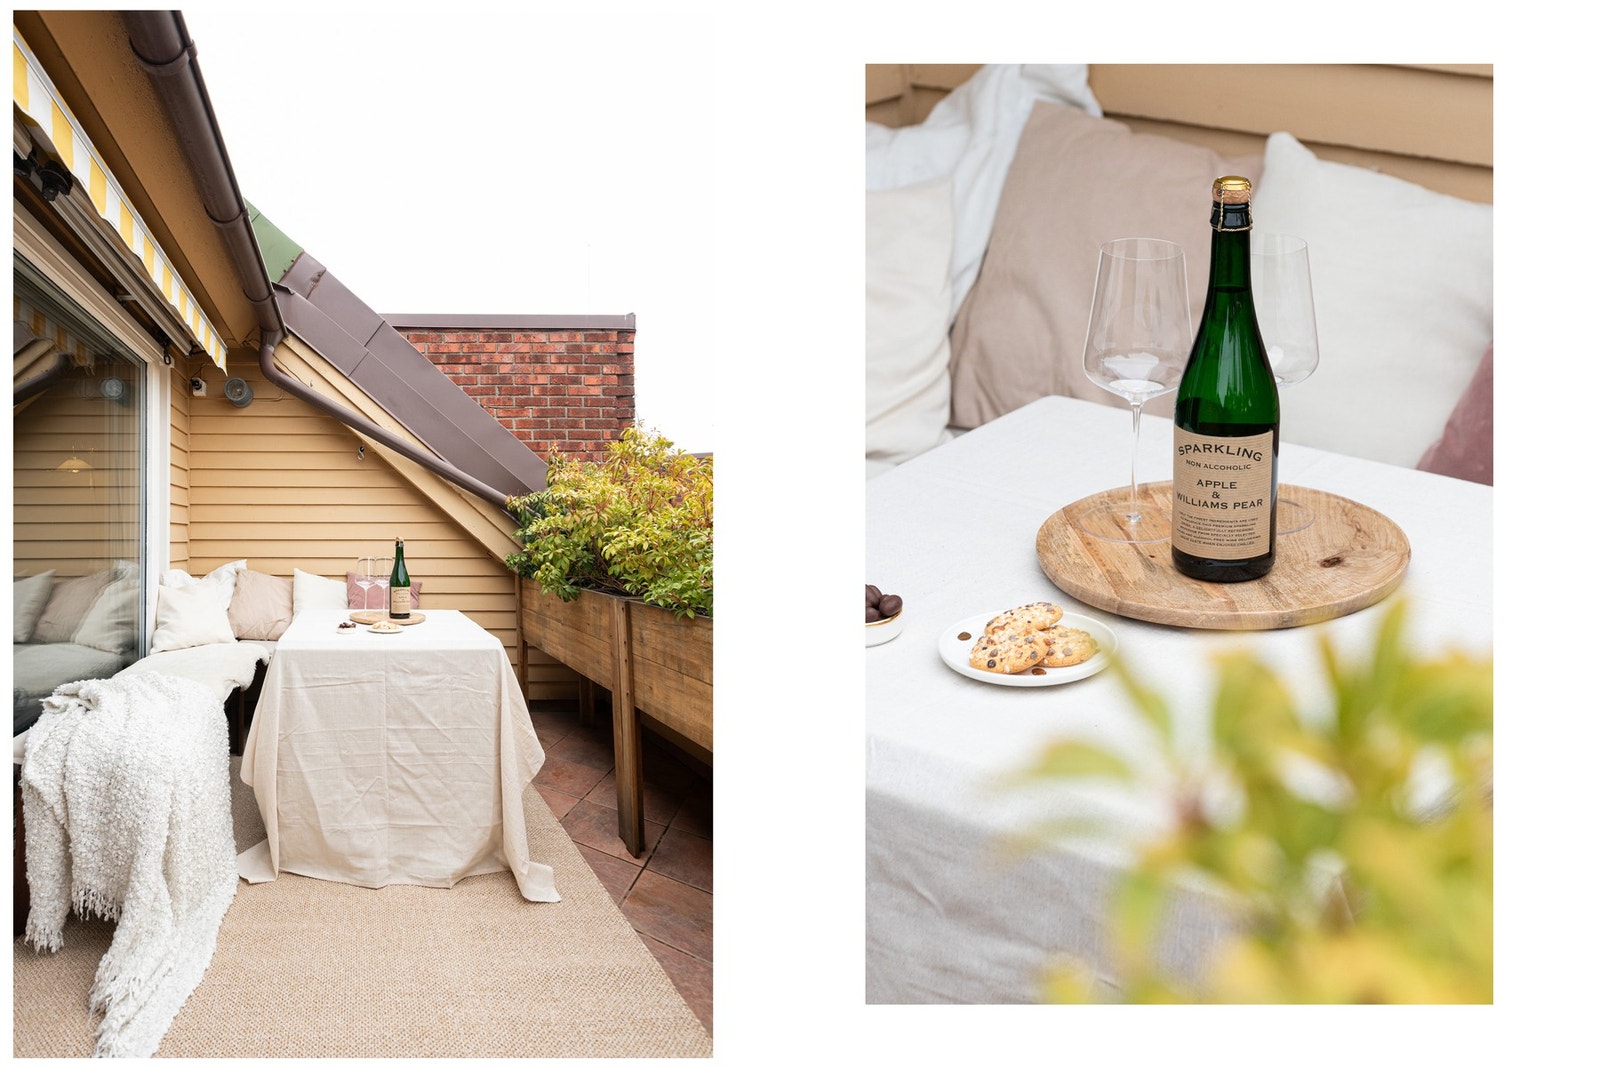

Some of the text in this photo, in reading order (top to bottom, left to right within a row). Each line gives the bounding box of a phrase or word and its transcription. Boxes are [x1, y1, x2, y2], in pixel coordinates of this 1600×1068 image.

[1178, 444, 1263, 462] SPARKLING
[1185, 459, 1201, 468] NON
[1196, 479, 1238, 490] APPLE
[1212, 491, 1220, 499] &
[1176, 492, 1263, 510] WILLIAMS PEAR
